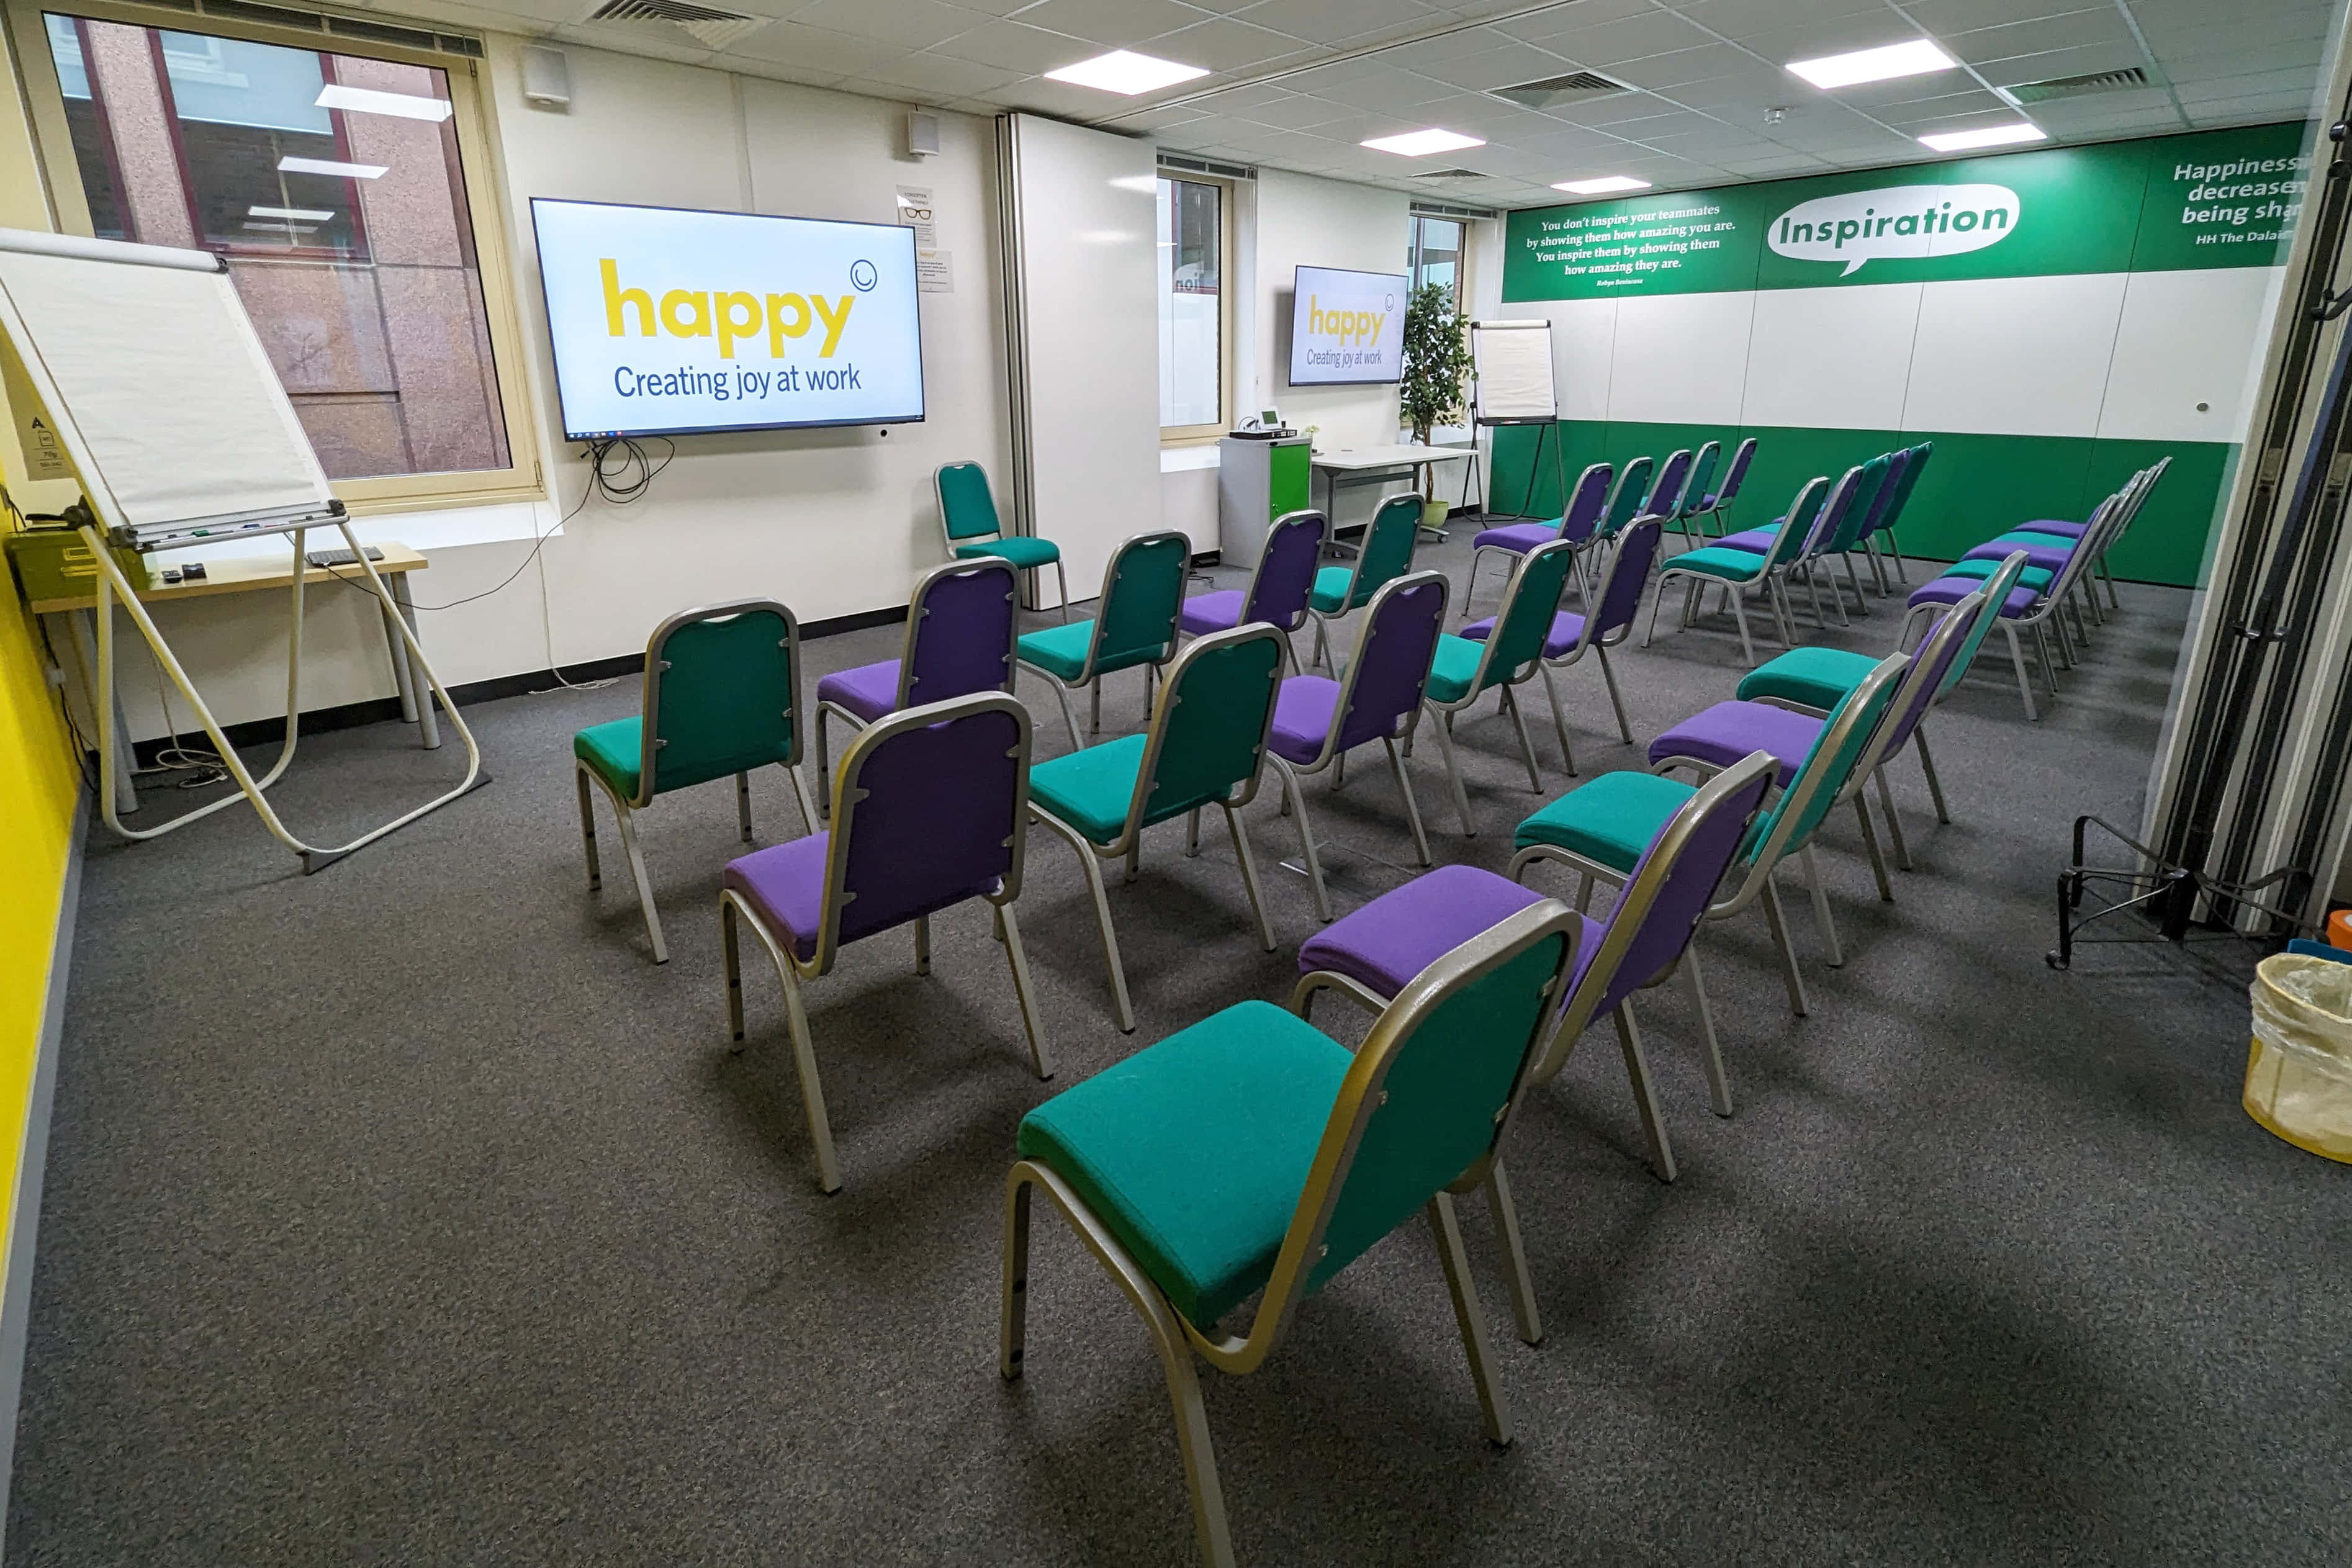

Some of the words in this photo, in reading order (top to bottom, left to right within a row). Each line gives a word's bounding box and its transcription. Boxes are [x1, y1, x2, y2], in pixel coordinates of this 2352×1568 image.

[2174, 158, 2299, 182] Happiness
[1541, 222, 1561, 231] You
[1563, 217, 1589, 229] don't
[1592, 214, 1628, 228] inspire
[1631, 212, 1656, 225] your
[1658, 205, 1720, 220] teammates
[1780, 202, 2008, 248] Inspiration
[2182, 205, 2250, 225] being
[2255, 201, 2291, 219] sh
[1526, 238, 1538, 250] by
[1540, 235, 1583, 246] showing
[1585, 232, 1611, 243] them
[1613, 230, 1637, 240] how
[1639, 225, 1687, 237] amazing
[1688, 224, 1711, 237] you
[1714, 222, 1736, 231] are.
[2196, 235, 2217, 245] HH
[2220, 233, 2244, 243] The
[1536, 253, 1555, 262] You
[1557, 249, 1592, 263] inspire
[1594, 247, 1621, 258] them
[1623, 245, 1638, 258] by
[1639, 241, 1688, 254] showing
[1690, 238, 1720, 250] them
[1564, 265, 1587, 275] how
[1588, 261, 1633, 274] amazing
[1635, 259, 1659, 273] they
[1661, 260, 1682, 269] are.
[599, 258, 856, 359] happy
[1309, 294, 1386, 347] happy
[1307, 348, 1341, 368] Creating
[1341, 349, 1354, 368] joy
[1354, 350, 1362, 364] at
[1364, 349, 1382, 364] work
[615, 366, 729, 401] Creating
[736, 364, 770, 400] joy
[777, 365, 800, 392] at
[806, 363, 862, 391] work
